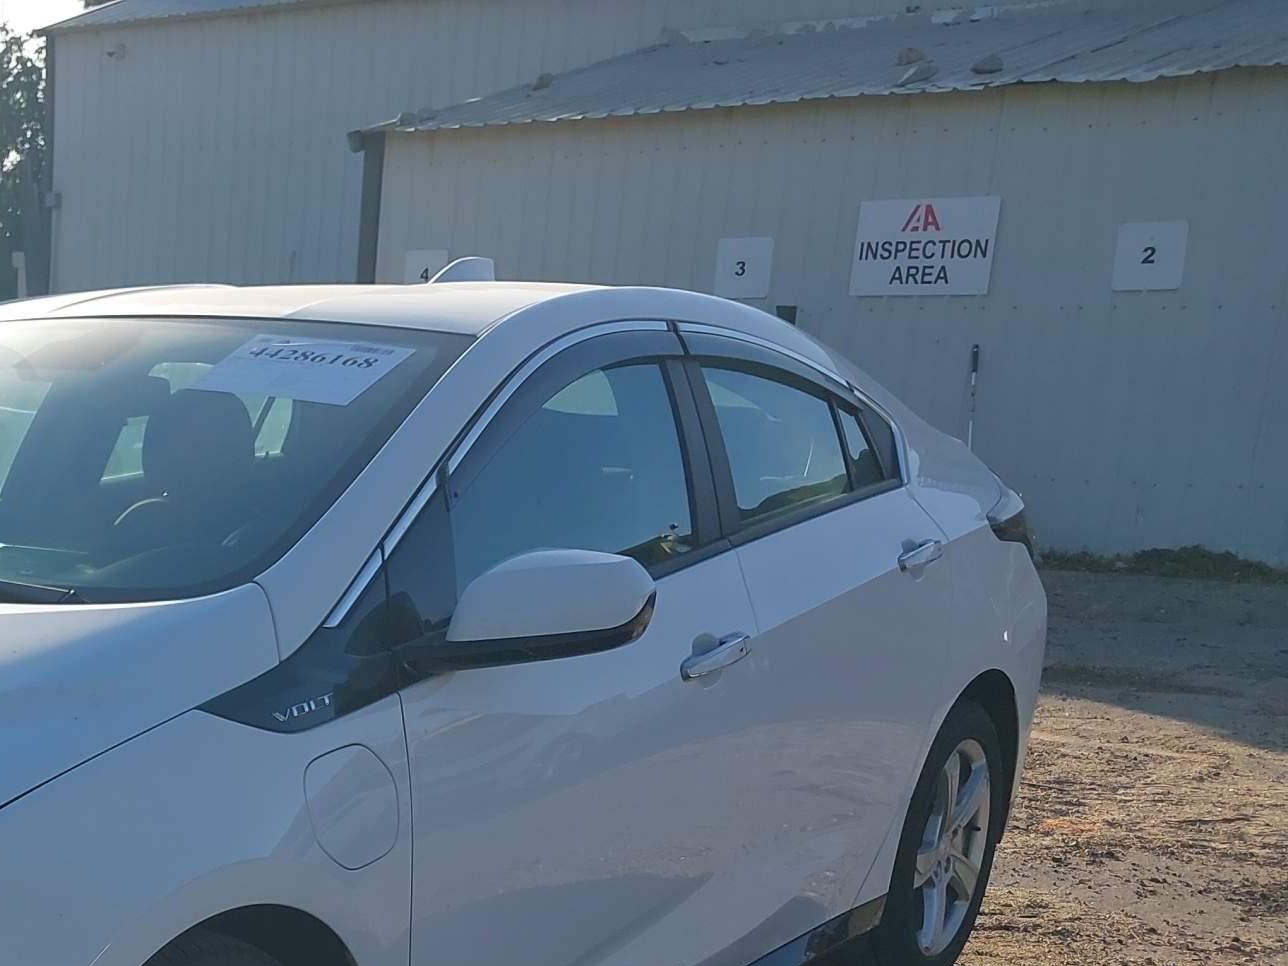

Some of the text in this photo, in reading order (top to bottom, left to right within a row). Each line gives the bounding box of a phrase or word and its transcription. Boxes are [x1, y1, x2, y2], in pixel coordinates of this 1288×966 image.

[858, 238, 990, 262] INSPECTION
[1141, 246, 1156, 264] 2
[419, 266, 430, 283] 4
[734, 260, 746, 277] 3
[888, 264, 950, 286] AREA
[248, 346, 379, 369] 44286168
[271, 692, 334, 723] VOLT
